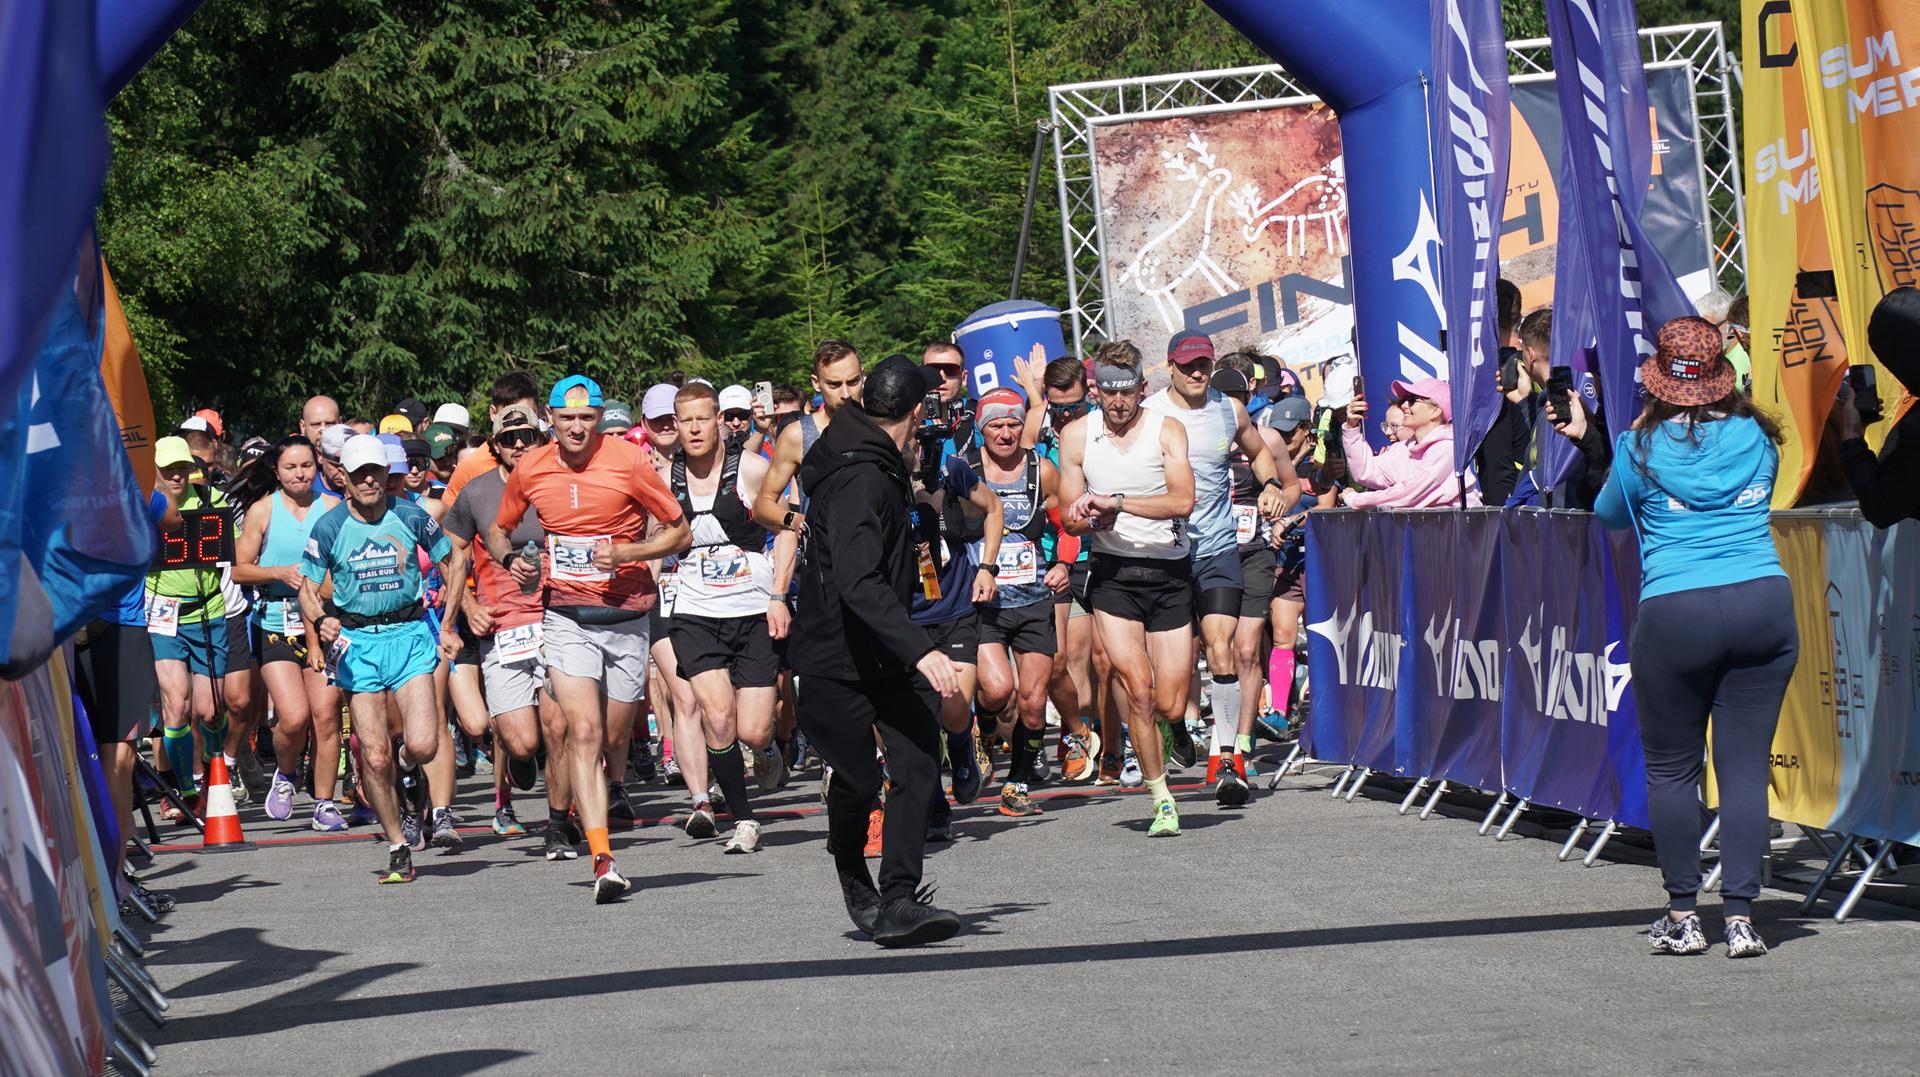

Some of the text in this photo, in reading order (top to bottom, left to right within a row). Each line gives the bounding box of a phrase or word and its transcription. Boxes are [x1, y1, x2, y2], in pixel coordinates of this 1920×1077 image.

[1820, 30, 1901, 89] SUM
[1755, 127, 1816, 184] SU
[1673, 358, 1699, 366] TOMMY
[1671, 371, 1697, 379] JEANS
[357, 568, 395, 581] TRAIL RUN
[361, 581, 400, 591] BY UTMB
